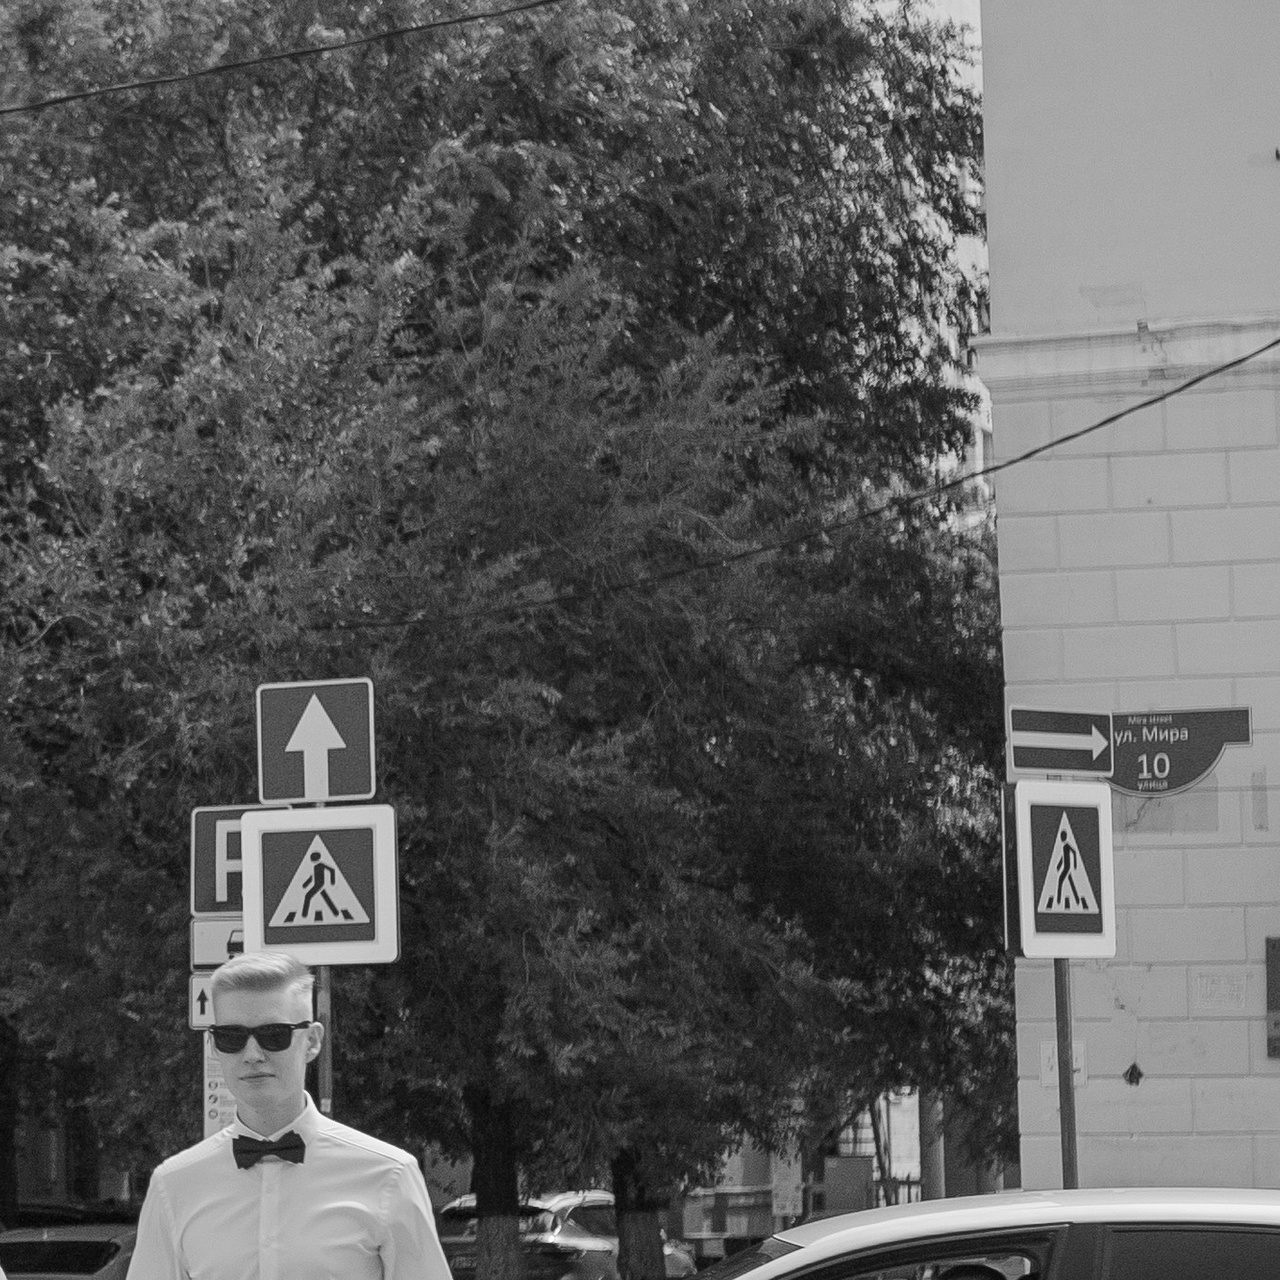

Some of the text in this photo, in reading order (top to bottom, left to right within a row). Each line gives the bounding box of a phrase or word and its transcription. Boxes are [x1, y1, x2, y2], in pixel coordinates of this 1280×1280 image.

[1115, 726, 1188, 747] ул. Мира
[1138, 752, 1170, 779] 10
